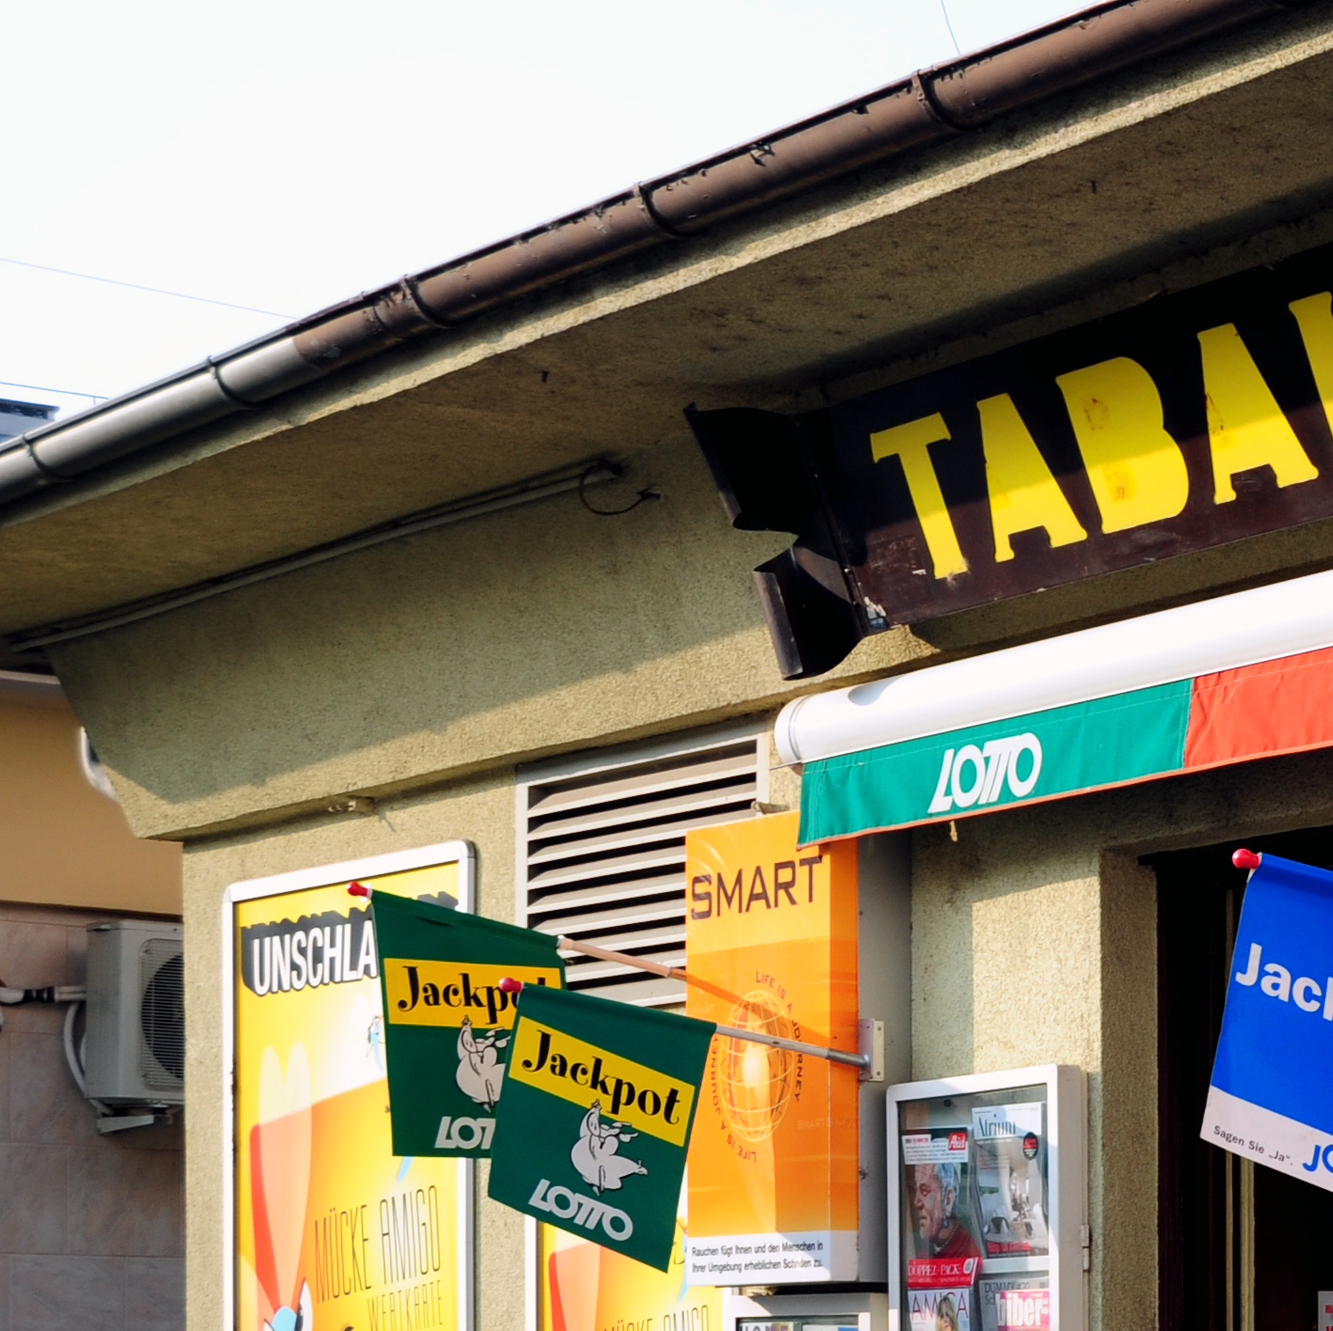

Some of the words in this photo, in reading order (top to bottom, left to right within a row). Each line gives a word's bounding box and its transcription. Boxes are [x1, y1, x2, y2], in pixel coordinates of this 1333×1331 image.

[926, 732, 1042, 814] LOTTO
[690, 855, 824, 921] SMART
[521, 1028, 681, 1126] Jackpot
[1213, 1124, 1245, 1147] Sagen
[1247, 1138, 1266, 1155] Sie
[527, 1177, 634, 1242] LOTTO
[315, 1207, 372, 1304] MÜCKE
[380, 1184, 441, 1286] AMIGO
[692, 1246, 719, 1257] Rauchen
[782, 1240, 816, 1252] Menschen
[995, 1292, 1044, 1327] biber
